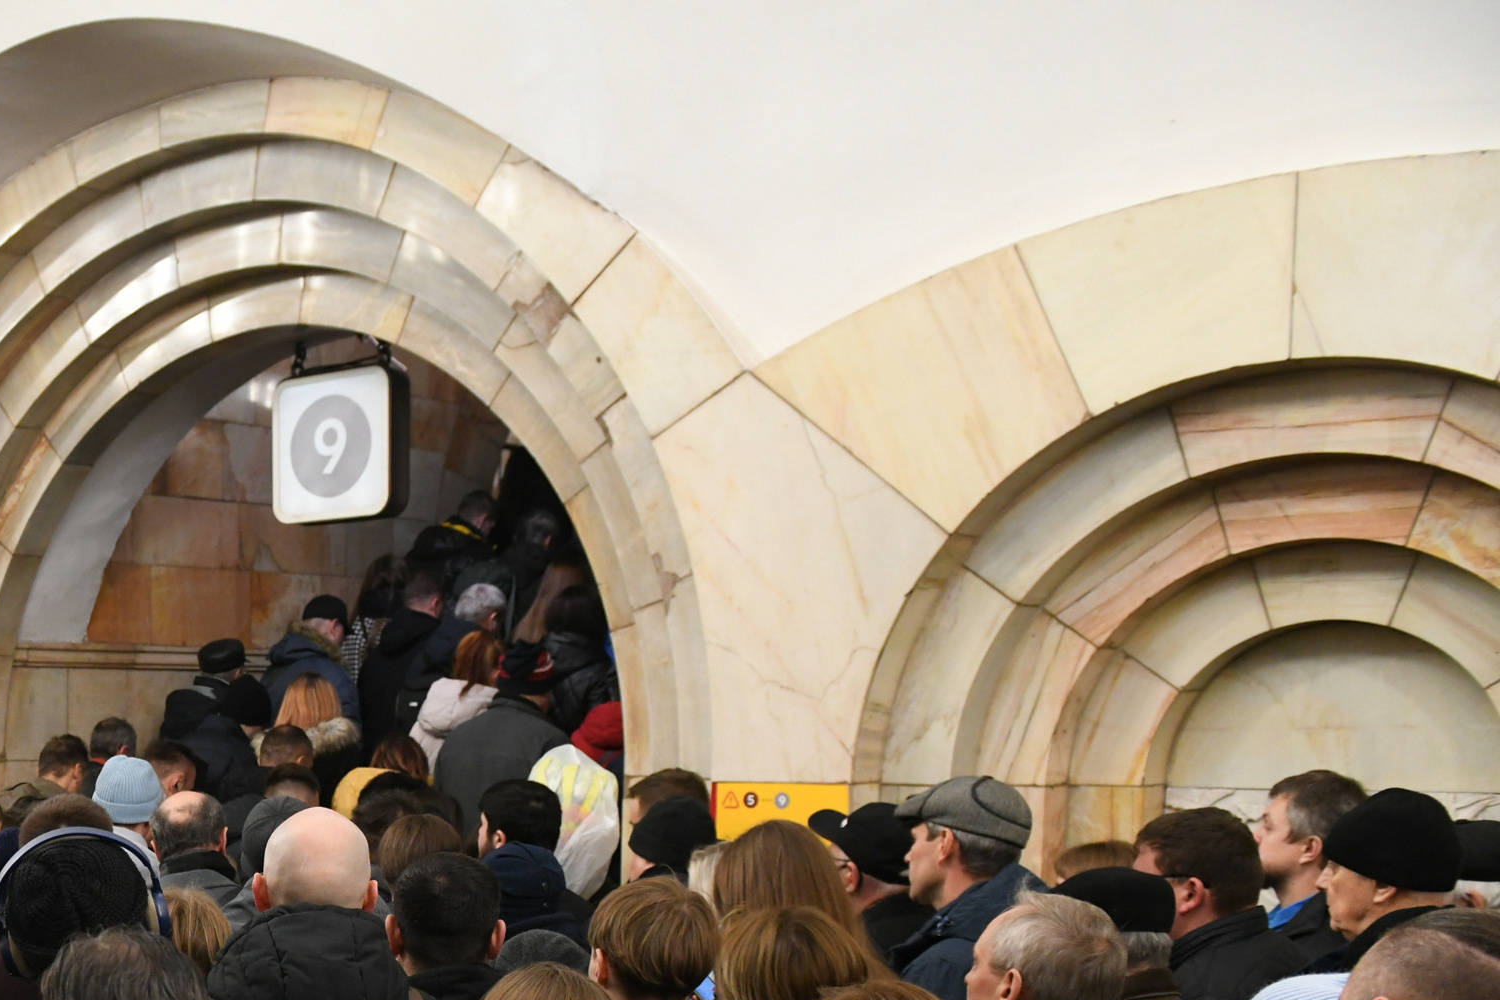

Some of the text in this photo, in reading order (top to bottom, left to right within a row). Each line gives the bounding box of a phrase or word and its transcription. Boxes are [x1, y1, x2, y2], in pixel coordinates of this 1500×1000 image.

[314, 417, 348, 475] 9
[746, 794, 787, 807] 5 9
